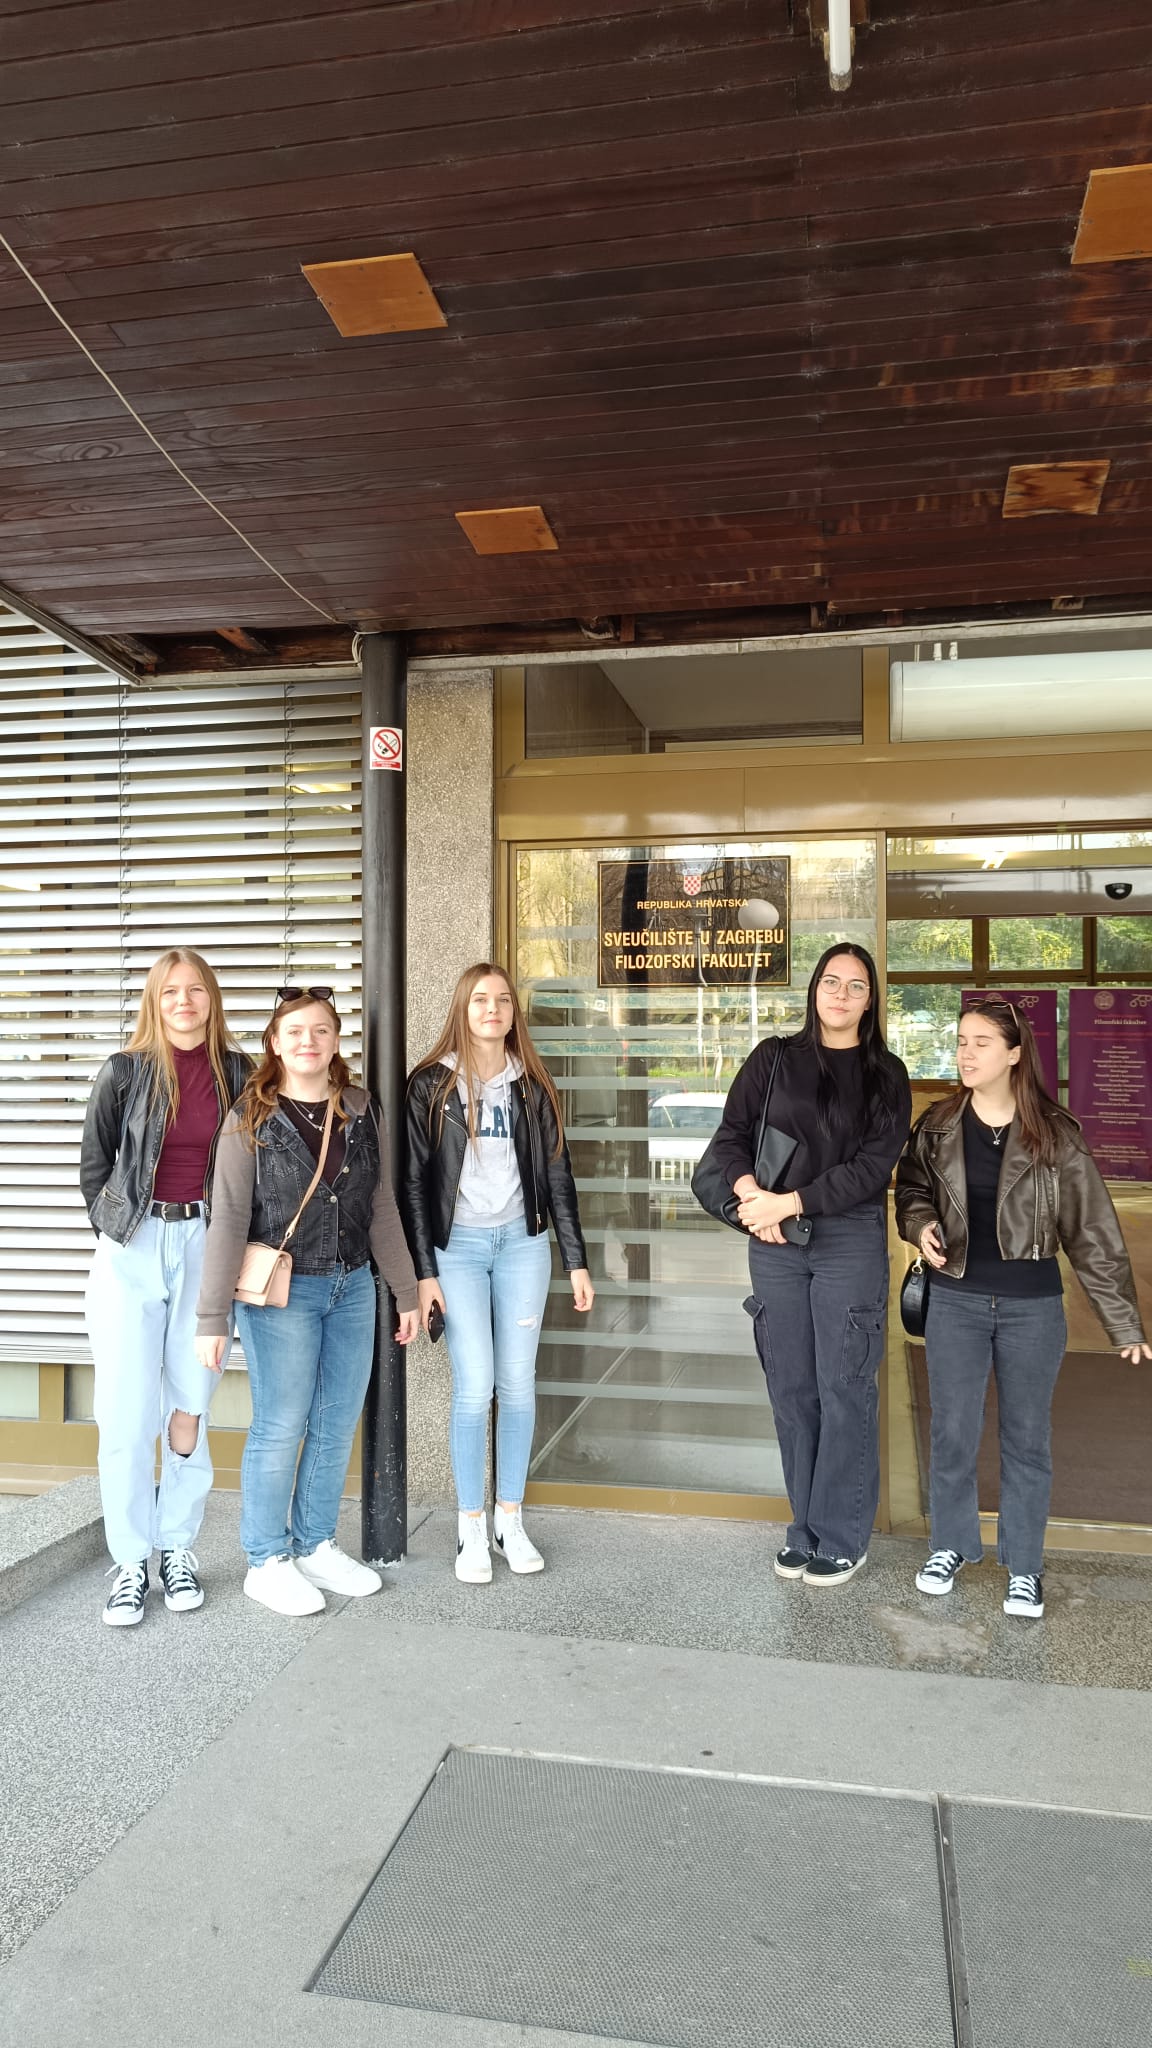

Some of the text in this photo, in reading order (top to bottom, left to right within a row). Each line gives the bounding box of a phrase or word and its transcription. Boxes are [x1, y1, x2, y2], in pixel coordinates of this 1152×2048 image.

[637, 899, 749, 910] REPUBLIKA HRVATSKA
[604, 928, 784, 947] SVEUČILIŠTE U ZAGREBU
[615, 952, 772, 970] FILOZOFSKI FAKULTET
